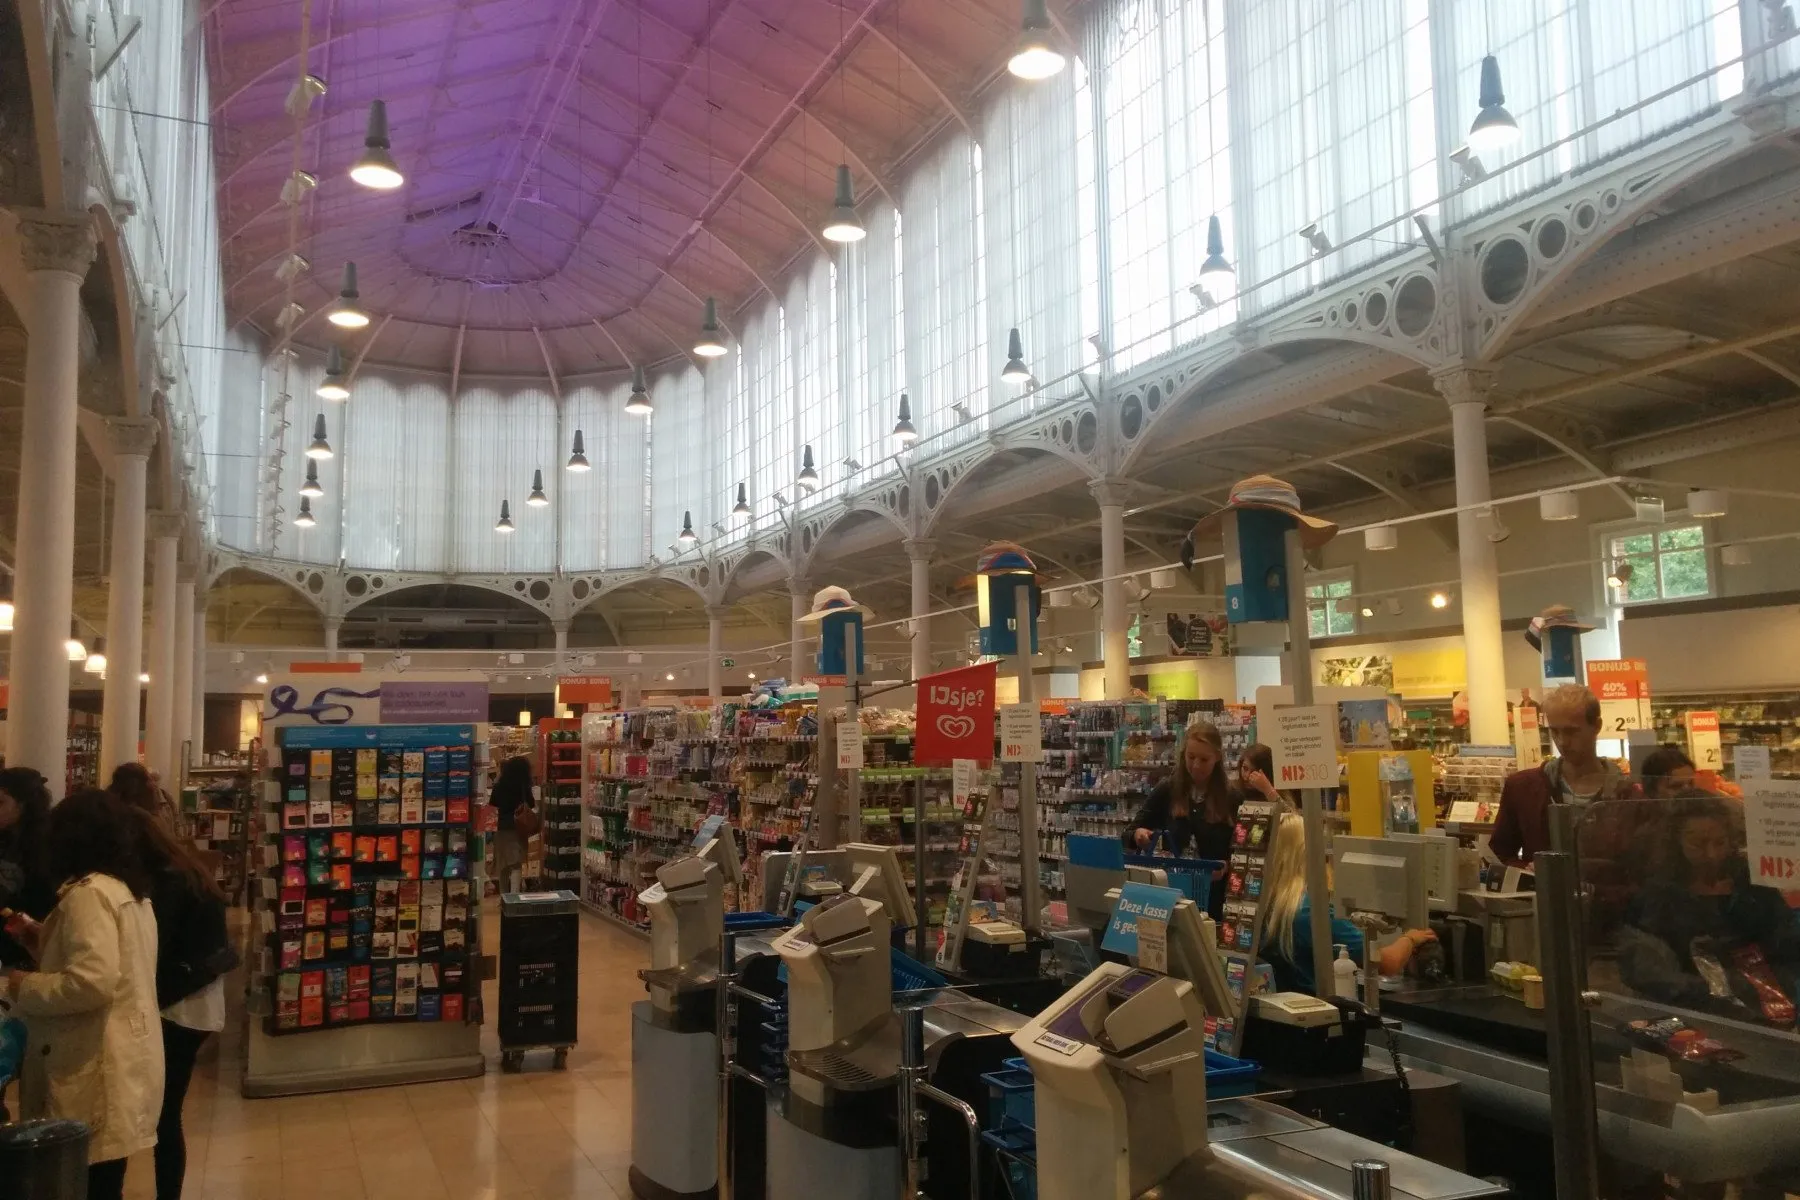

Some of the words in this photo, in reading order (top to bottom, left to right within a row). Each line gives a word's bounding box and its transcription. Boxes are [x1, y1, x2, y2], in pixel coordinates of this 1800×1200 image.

[1231, 596, 1239, 609] 8
[1589, 661, 1631, 672] BONUS
[560, 677, 587, 685] BONUS
[1602, 682, 1627, 692] 40%
[929, 685, 985, 712] IJsje?
[1119, 899, 1142, 914] Deze
[1142, 902, 1168, 919] kassa
[1113, 916, 1121, 930] is
